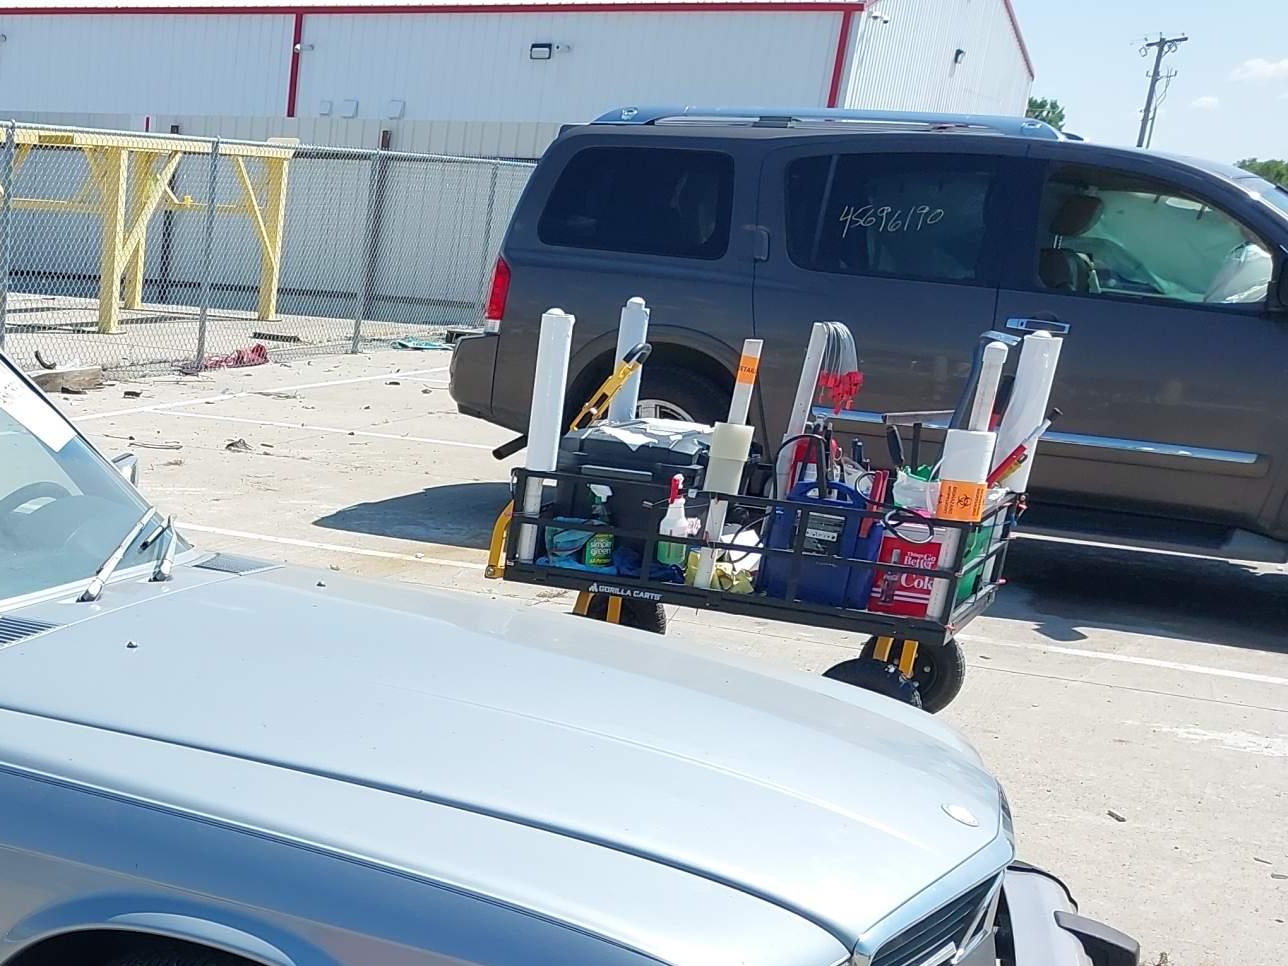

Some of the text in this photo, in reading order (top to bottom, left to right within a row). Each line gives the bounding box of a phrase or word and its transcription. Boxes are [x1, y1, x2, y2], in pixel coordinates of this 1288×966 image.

[590, 548, 612, 556] green
[904, 556, 935, 569] Better
[900, 573, 934, 590] Cok
[598, 585, 632, 597] GORILLA
